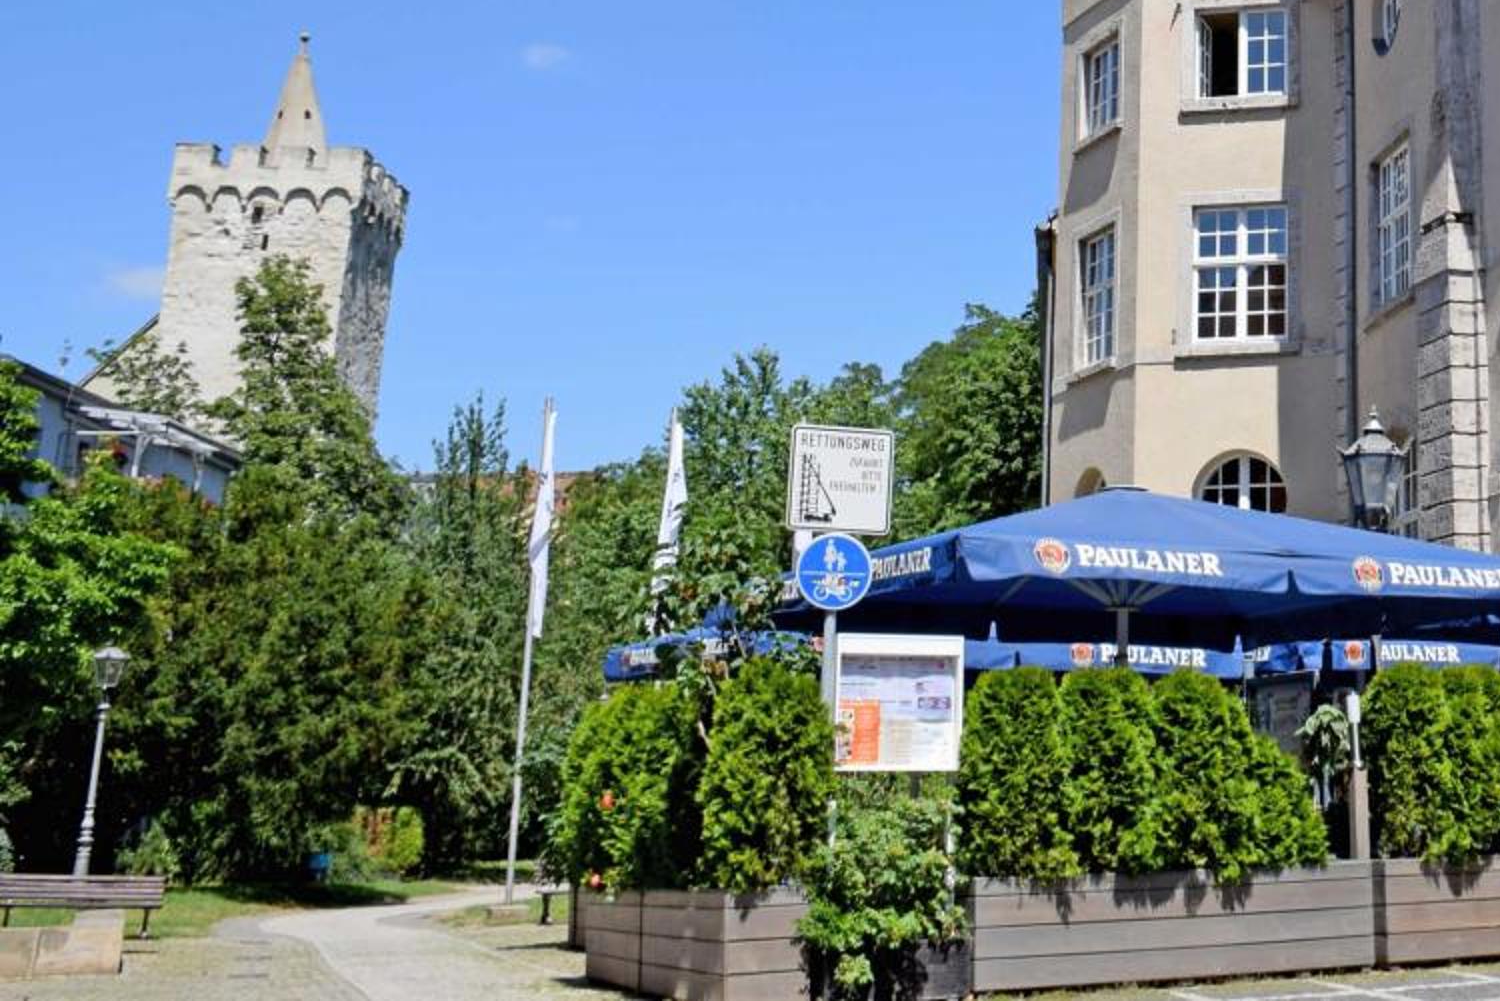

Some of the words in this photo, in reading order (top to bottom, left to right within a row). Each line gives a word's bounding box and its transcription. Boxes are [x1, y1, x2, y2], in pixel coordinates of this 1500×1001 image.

[801, 433, 885, 452] RETTUNGSWEG
[871, 547, 931, 580] PAULANER
[1074, 544, 1223, 576] PAULANER
[1381, 644, 1460, 662] AULANER
